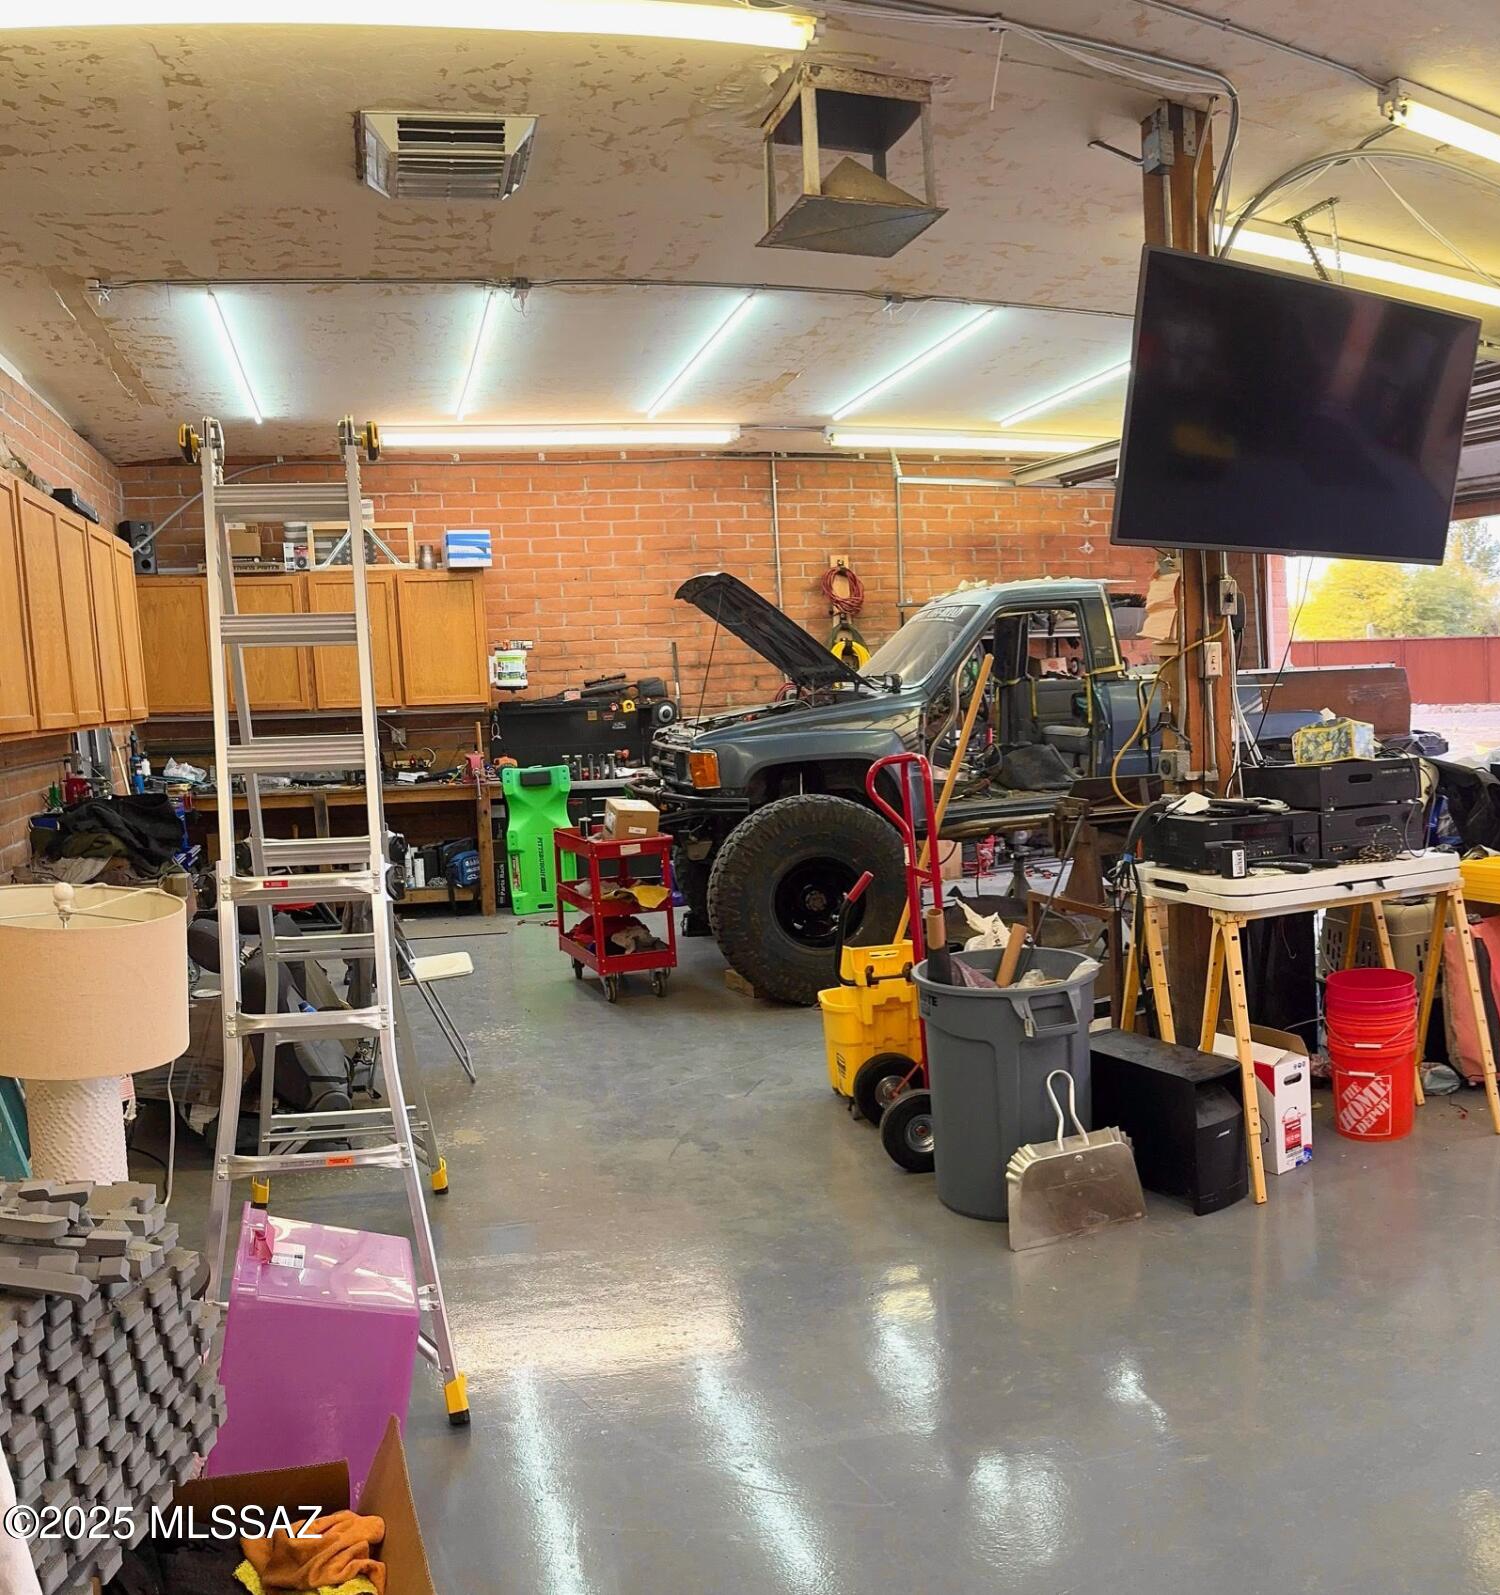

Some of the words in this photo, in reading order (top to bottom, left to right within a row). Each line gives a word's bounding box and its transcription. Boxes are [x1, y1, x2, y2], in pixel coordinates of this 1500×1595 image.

[1340, 1077, 1391, 1131] HOME
[1342, 1082, 1361, 1103] THE
[1356, 1098, 1391, 1134] DEPOT
